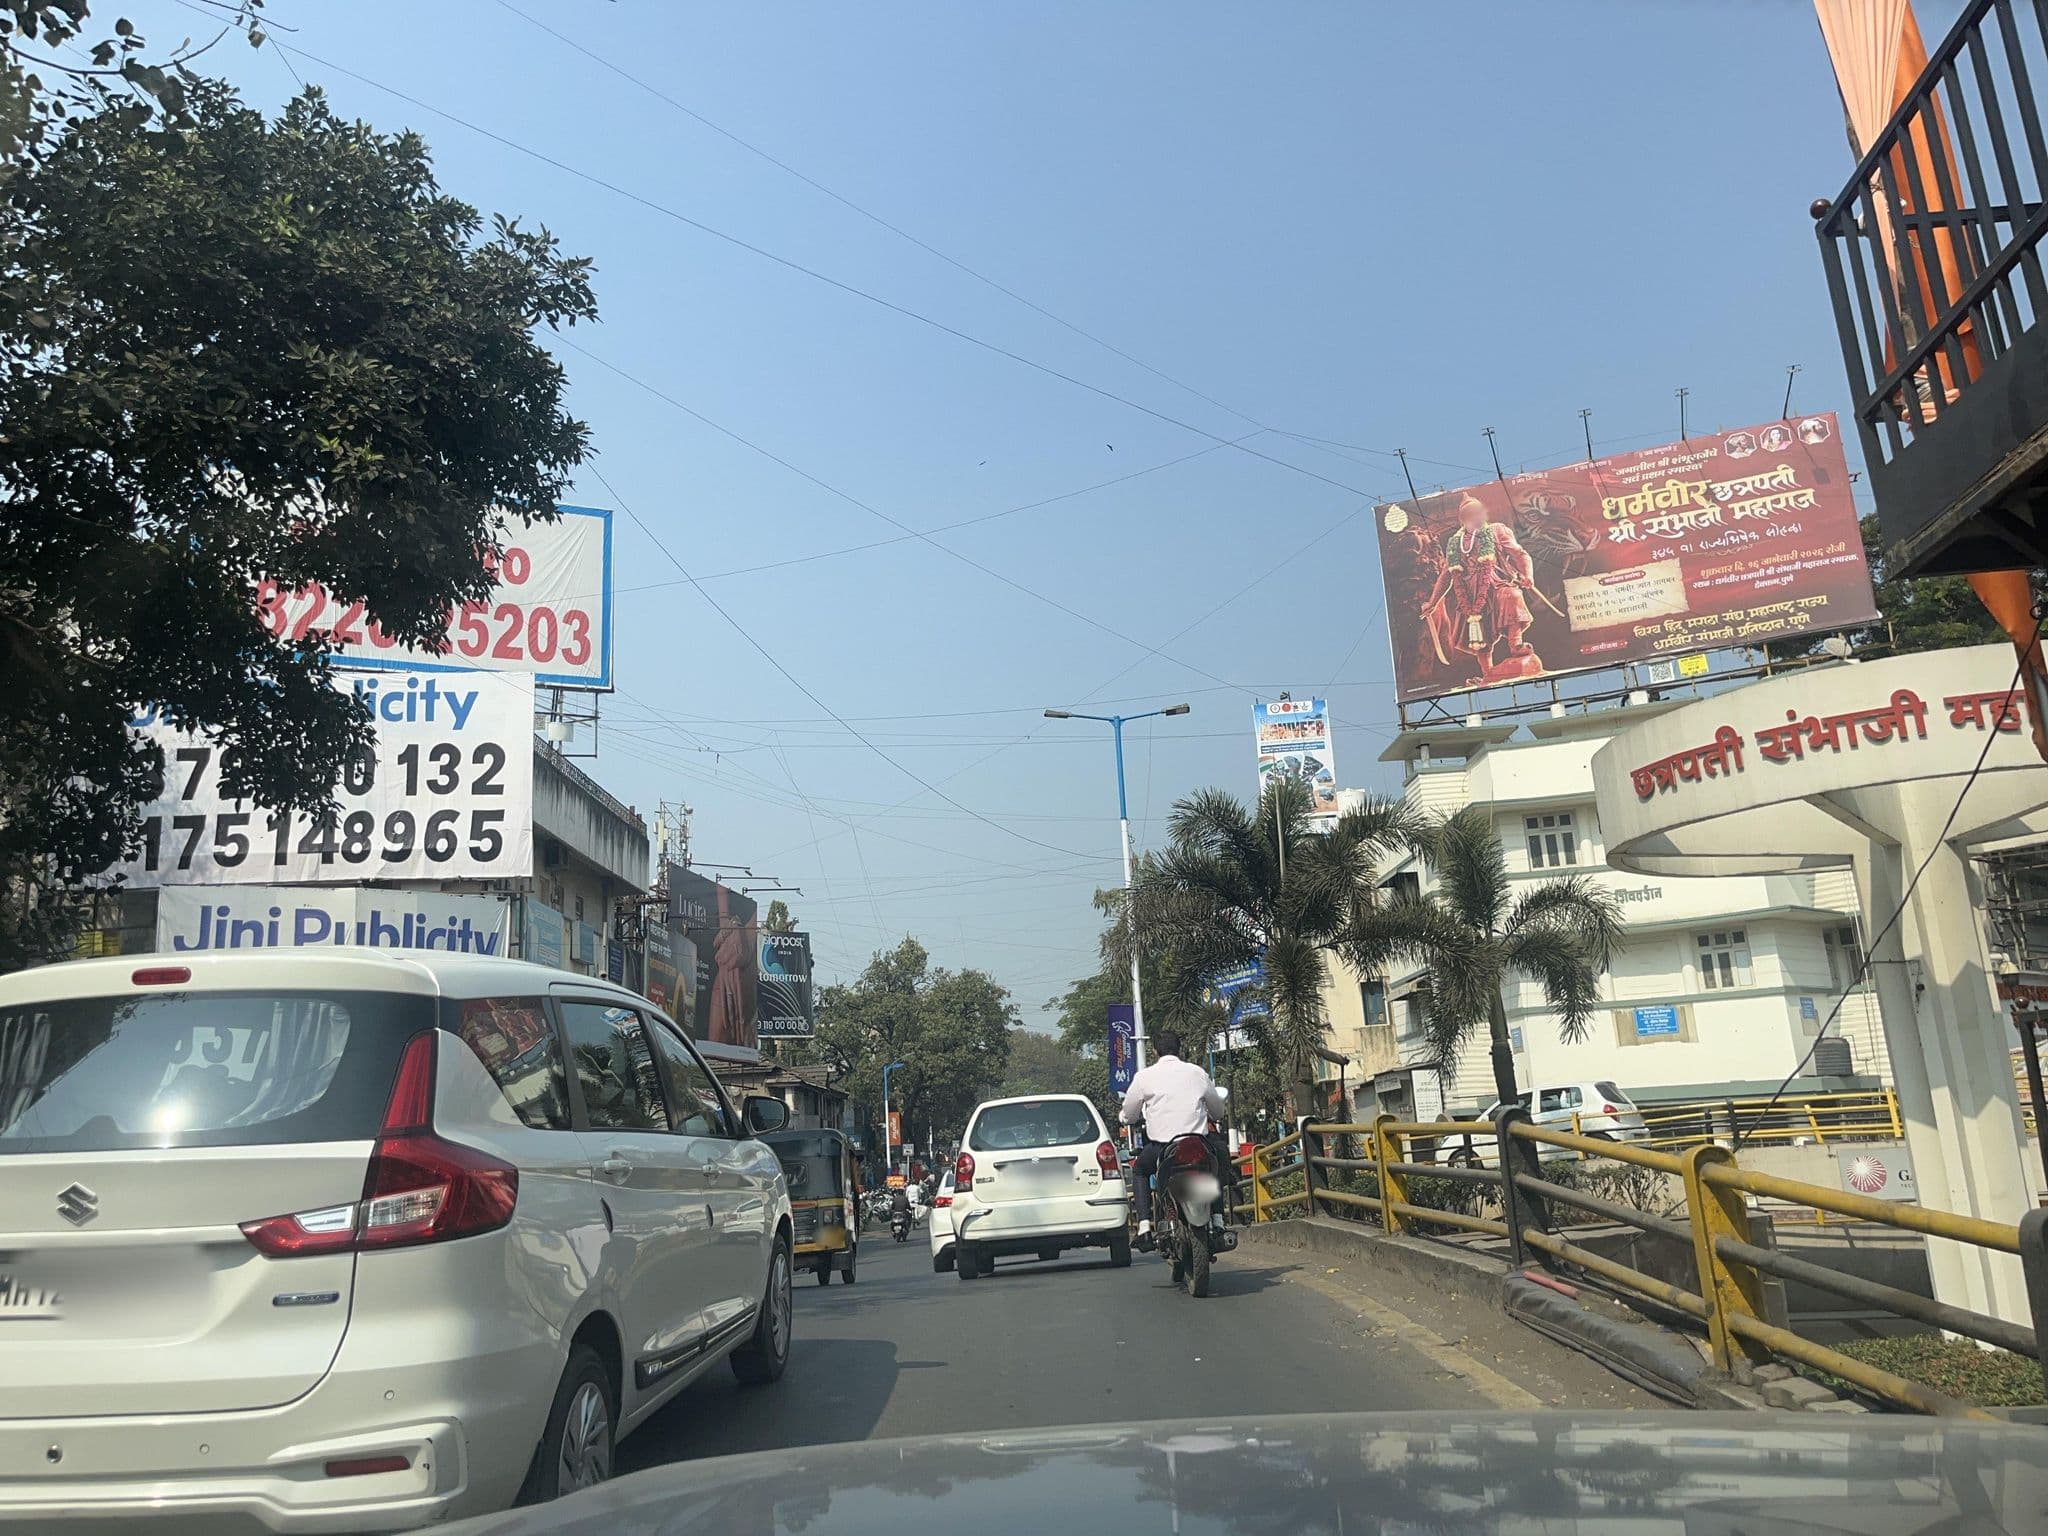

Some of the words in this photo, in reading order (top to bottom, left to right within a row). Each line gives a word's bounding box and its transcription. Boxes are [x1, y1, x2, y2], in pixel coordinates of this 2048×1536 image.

[1602, 479, 1712, 520] धर्मवीर
[1710, 464, 1801, 502] छत्रपती
[1728, 488, 1820, 519] महाराज
[1653, 632, 1693, 650] धर्मवीर
[1696, 625, 1735, 642] संभाजी
[1630, 724, 1745, 798] छत्रपती
[1755, 689, 1927, 762] संभाजी
[173, 904, 282, 951] Jini
[294, 907, 499, 956] Publicity
[759, 973, 807, 983] tomorrow
